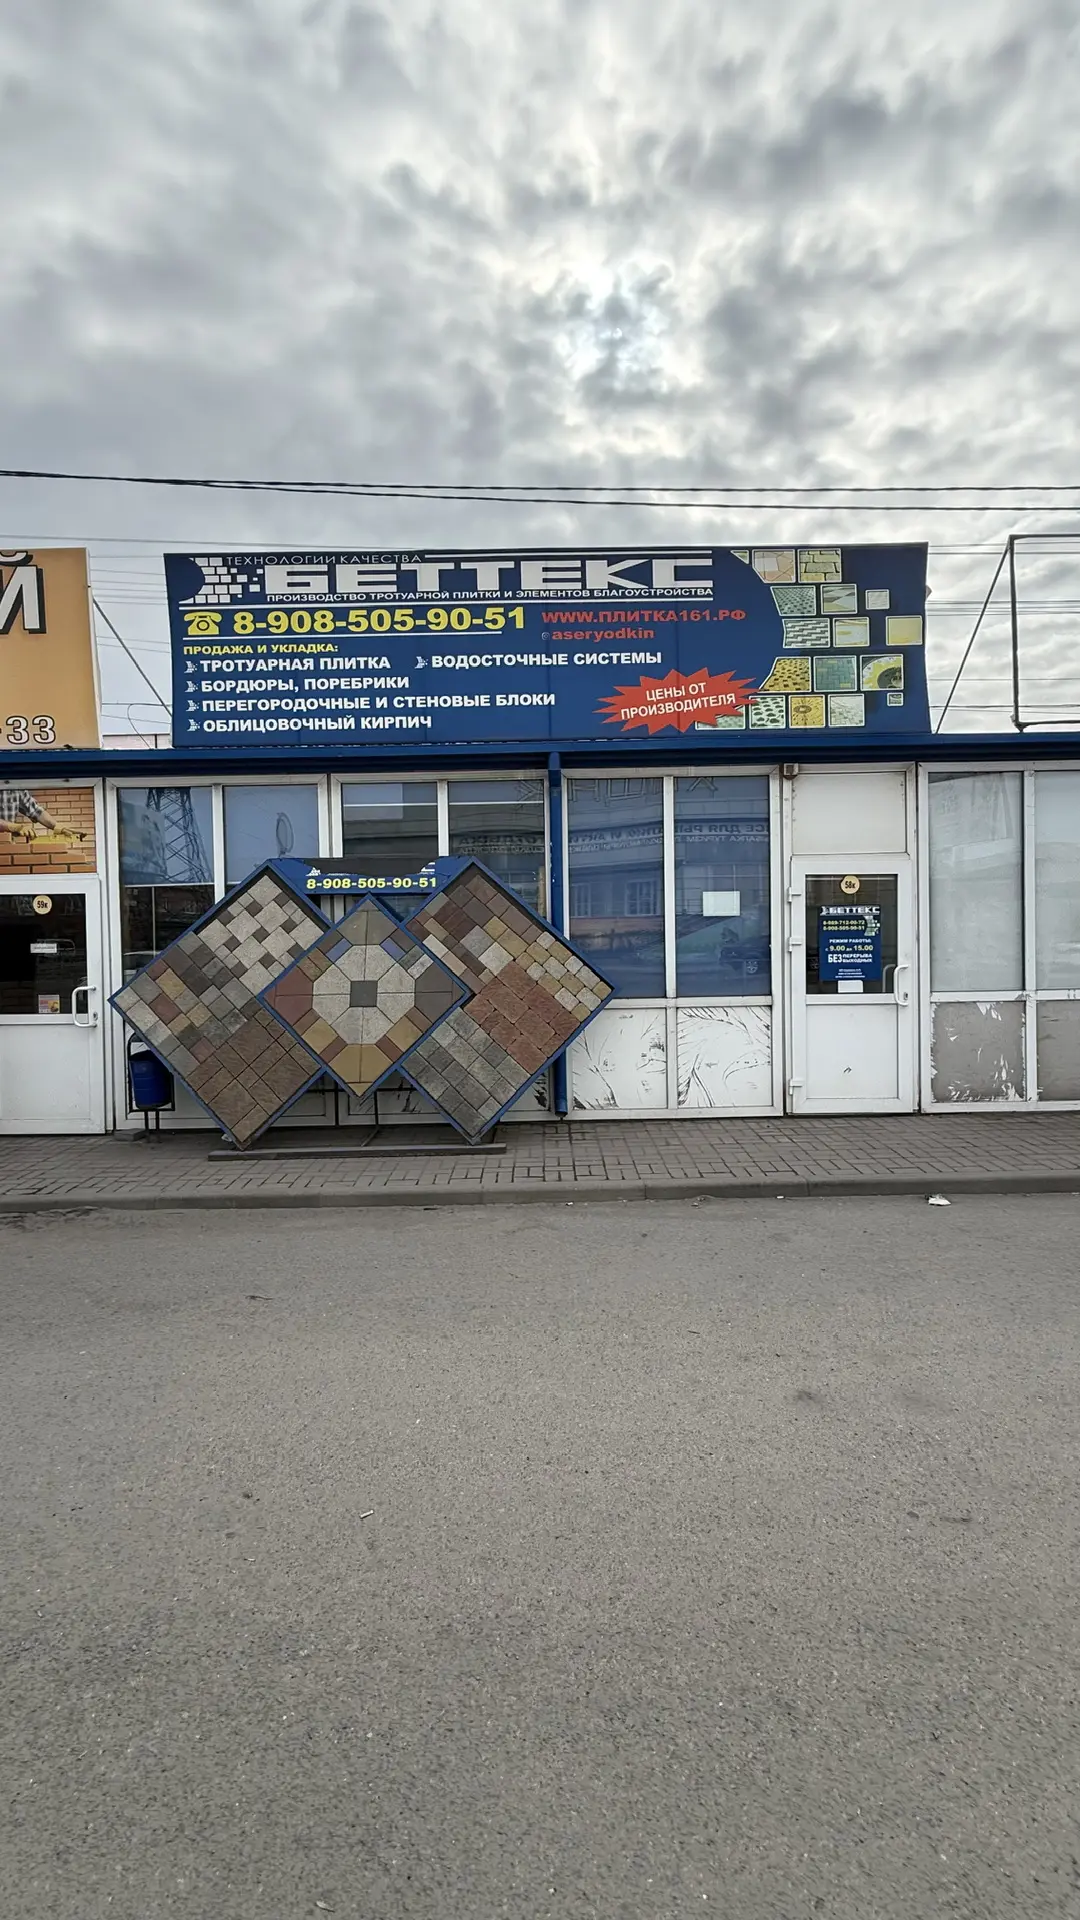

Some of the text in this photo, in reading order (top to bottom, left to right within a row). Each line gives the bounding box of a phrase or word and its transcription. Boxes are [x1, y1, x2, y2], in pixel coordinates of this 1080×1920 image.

[226, 554, 422, 566] ТЕХНОЛОГИИ КАЧЕСТВА
[265, 558, 713, 594] БЕТТЕКС
[267, 592, 367, 602] ПРОИЗВОДСТВО
[369, 590, 450, 601] ТРОТУАРНОЙ
[453, 590, 501, 600] ПЛИТКИ
[515, 588, 591, 598] ЭЛЕМЕНТОВ
[594, 586, 713, 597] БЛАГОУСТРОЙСТВА
[233, 606, 525, 635] 8-908-505-90-51
[552, 628, 655, 642] aseryodkin
[183, 643, 339, 656] ПРОДАЖА И УКЛАДКА:
[200, 657, 390, 673] ТРОТУАРНАЯ ПЛИТКА
[432, 652, 662, 669] ВОДОСТОЧНЫЕ СИСТЕМЫ
[201, 677, 409, 693] БОРДЮРЫ, ПОРЕБРИКИ
[646, 683, 706, 702] ЦЕНЫ ОТ
[202, 693, 556, 713] ПЕРЕГОРОДОЧНЫЕ И СТЕНОВЫЕ БЛОКИ
[620, 693, 737, 720] ПРОИЗВОДИТЕЛЯ
[203, 716, 432, 733] ОБЛИЦОВОЧНЫЙ КИРПИЧ
[306, 878, 436, 889] 8-908-505-90-51
[828, 954, 842, 963] БЕЗ
